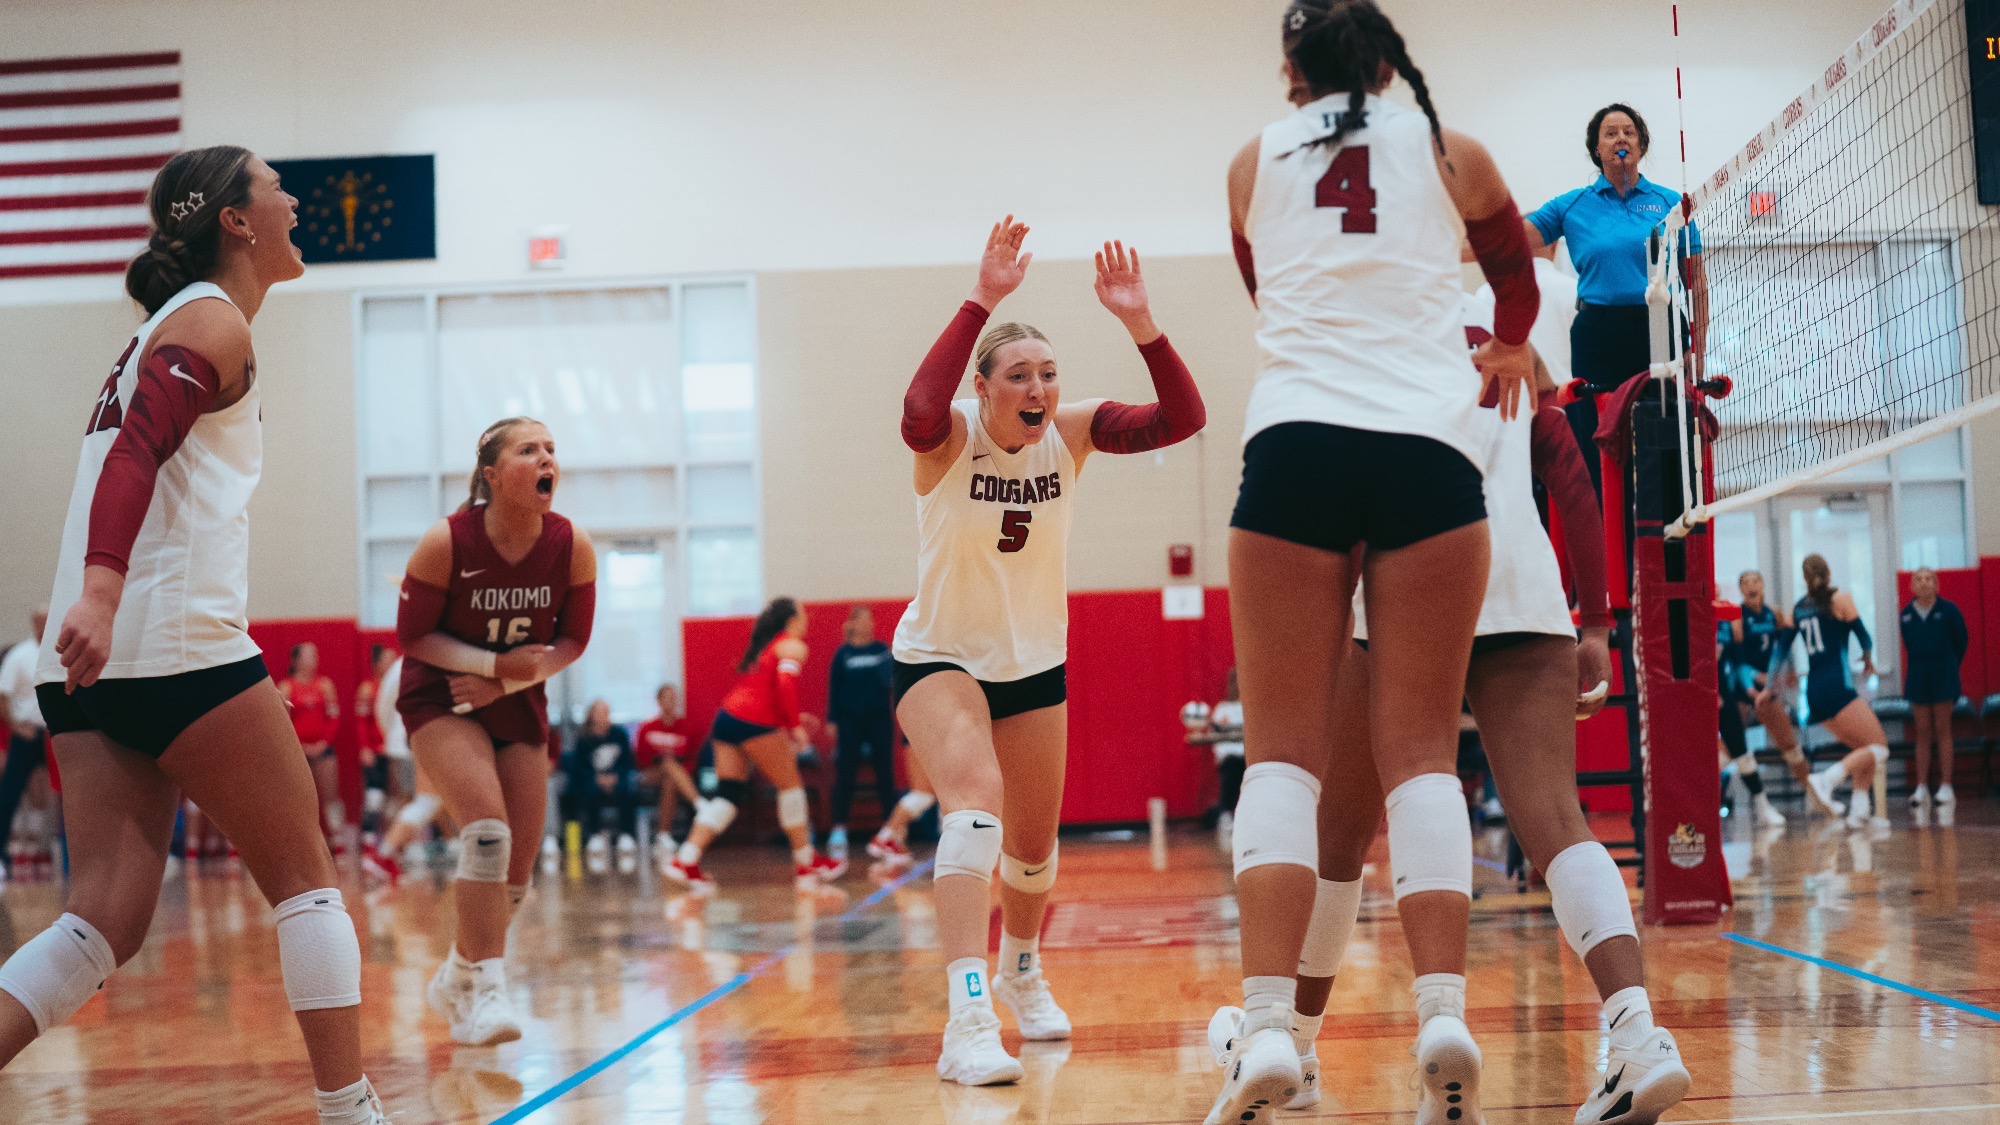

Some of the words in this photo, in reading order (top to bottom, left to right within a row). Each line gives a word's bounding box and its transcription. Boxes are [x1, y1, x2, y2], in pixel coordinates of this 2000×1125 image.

[1315, 145, 1377, 234] 4
[970, 472, 1061, 504] COUGARS
[997, 510, 1032, 553] 5
[470, 586, 551, 610] KOKOMO
[487, 617, 532, 645] 16
